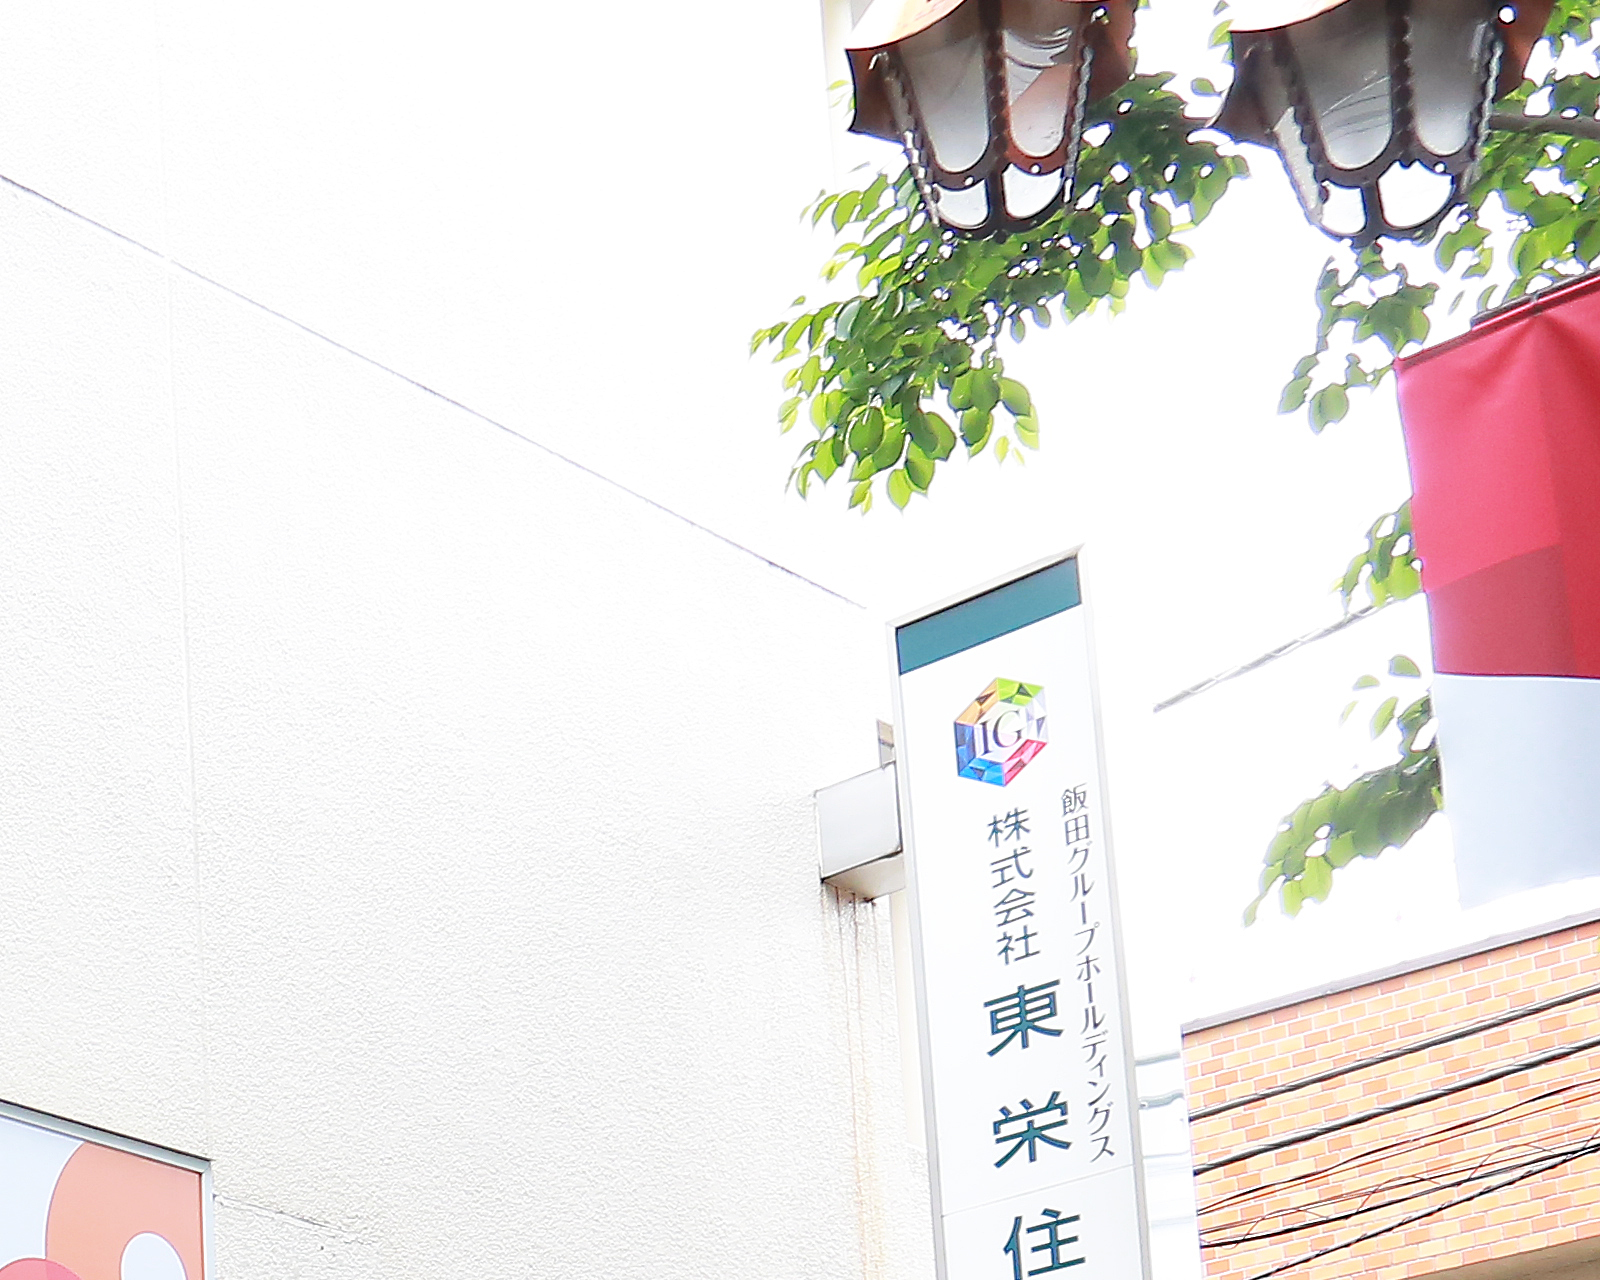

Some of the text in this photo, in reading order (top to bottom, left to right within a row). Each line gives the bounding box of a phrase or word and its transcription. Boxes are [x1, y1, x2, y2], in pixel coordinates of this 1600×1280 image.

[979, 709, 1024, 755] IG
[1061, 782, 1116, 1164] 飯田グループホールディングス
